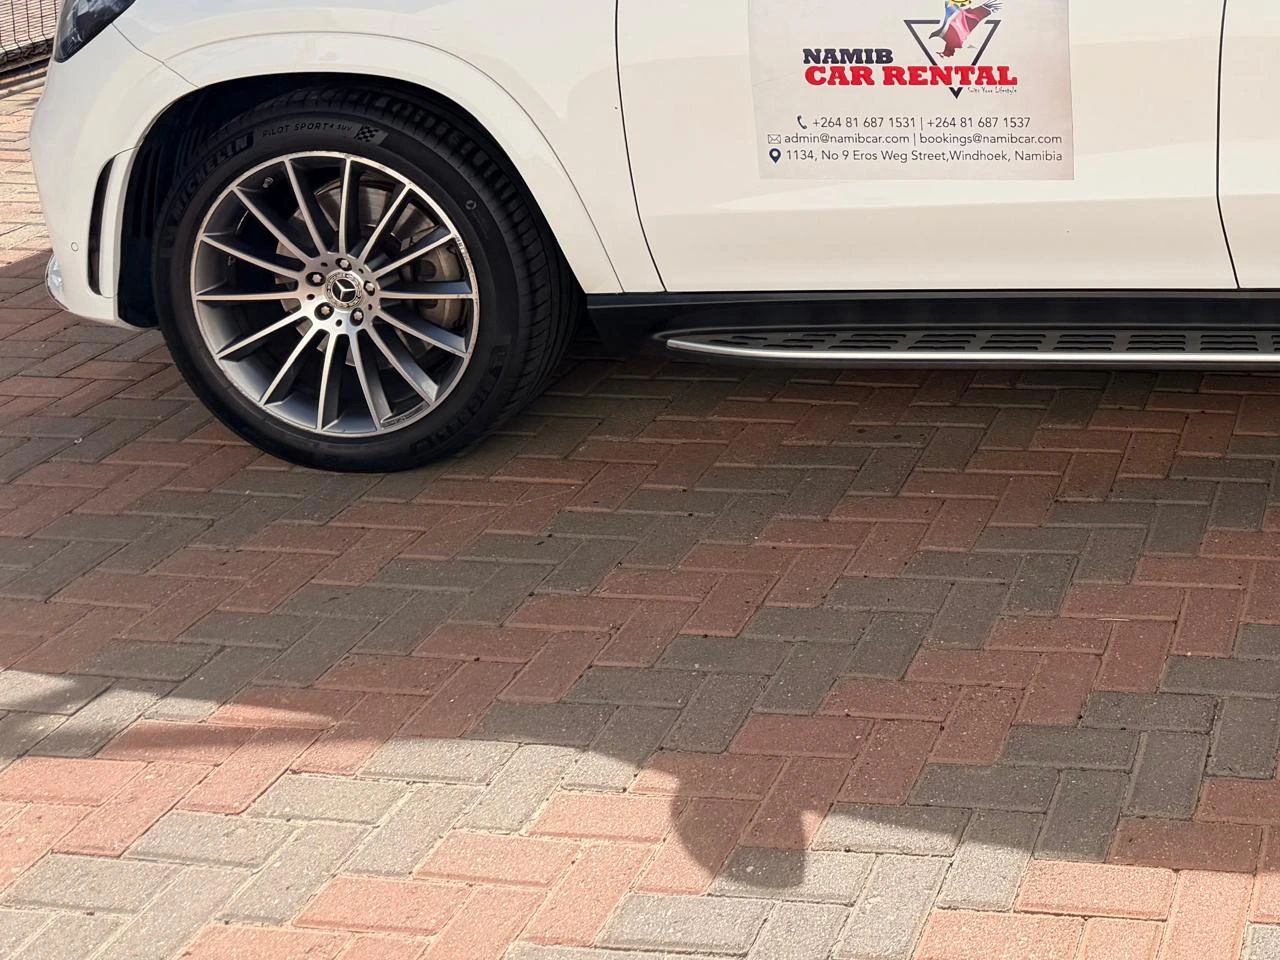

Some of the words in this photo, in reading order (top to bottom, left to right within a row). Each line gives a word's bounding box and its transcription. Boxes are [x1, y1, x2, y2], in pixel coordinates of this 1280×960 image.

[803, 48, 894, 65] NAMIB
[804, 65, 875, 86] CAR
[882, 65, 1018, 86] RENTAL
[812, 116, 842, 128] +264
[845, 116, 859, 128] 81
[863, 116, 884, 128] 687
[888, 116, 916, 128] 1531
[927, 116, 957, 128] +264
[960, 116, 973, 128] 81
[977, 116, 999, 128] 687
[1003, 116, 1031, 128] 1537
[262, 125, 290, 138] PILOT
[293, 122, 329, 131] SPORT
[784, 133, 910, 144] admin@namibcar.com
[919, 132, 1063, 146] bookings@namibcar.com
[786, 149, 818, 161] 1134,
[821, 149, 839, 161] No
[842, 149, 850, 161] 9
[853, 149, 878, 161] Eros
[880, 149, 908, 164] Weg
[1014, 150, 1063, 161] Namibia
